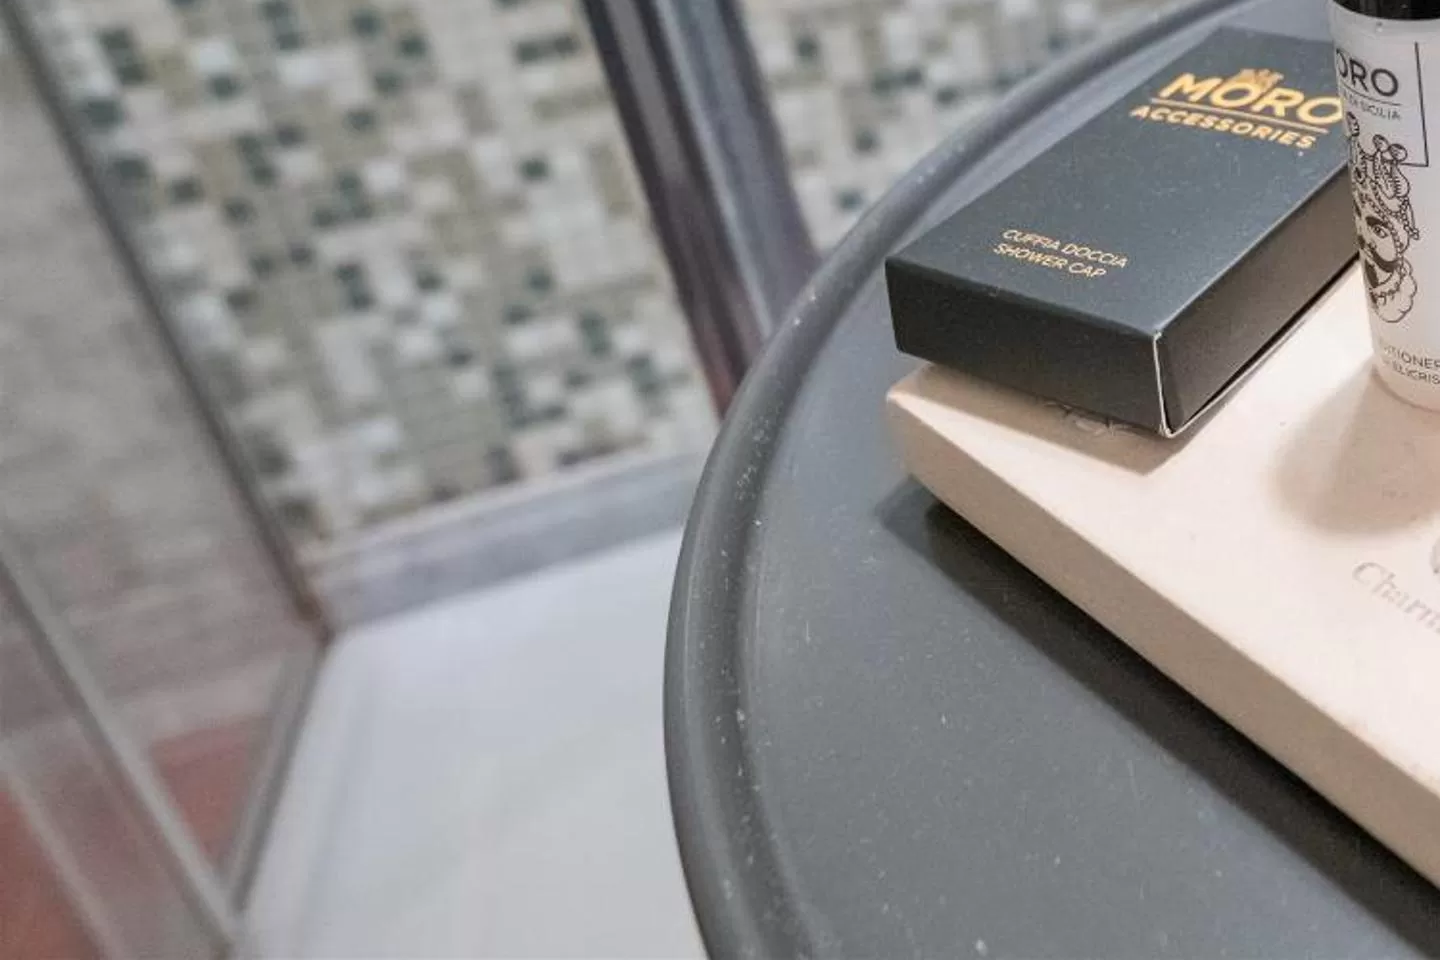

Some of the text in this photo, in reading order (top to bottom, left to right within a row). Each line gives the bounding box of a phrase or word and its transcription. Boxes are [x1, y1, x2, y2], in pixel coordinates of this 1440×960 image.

[1336, 48, 1399, 98] ORO
[1158, 72, 1343, 125] MORO
[1129, 104, 1317, 149] ACCESSORIES
[993, 243, 1107, 279] SHOWER CAP
[1002, 228, 1129, 269] CUFFIA DOCCIA
